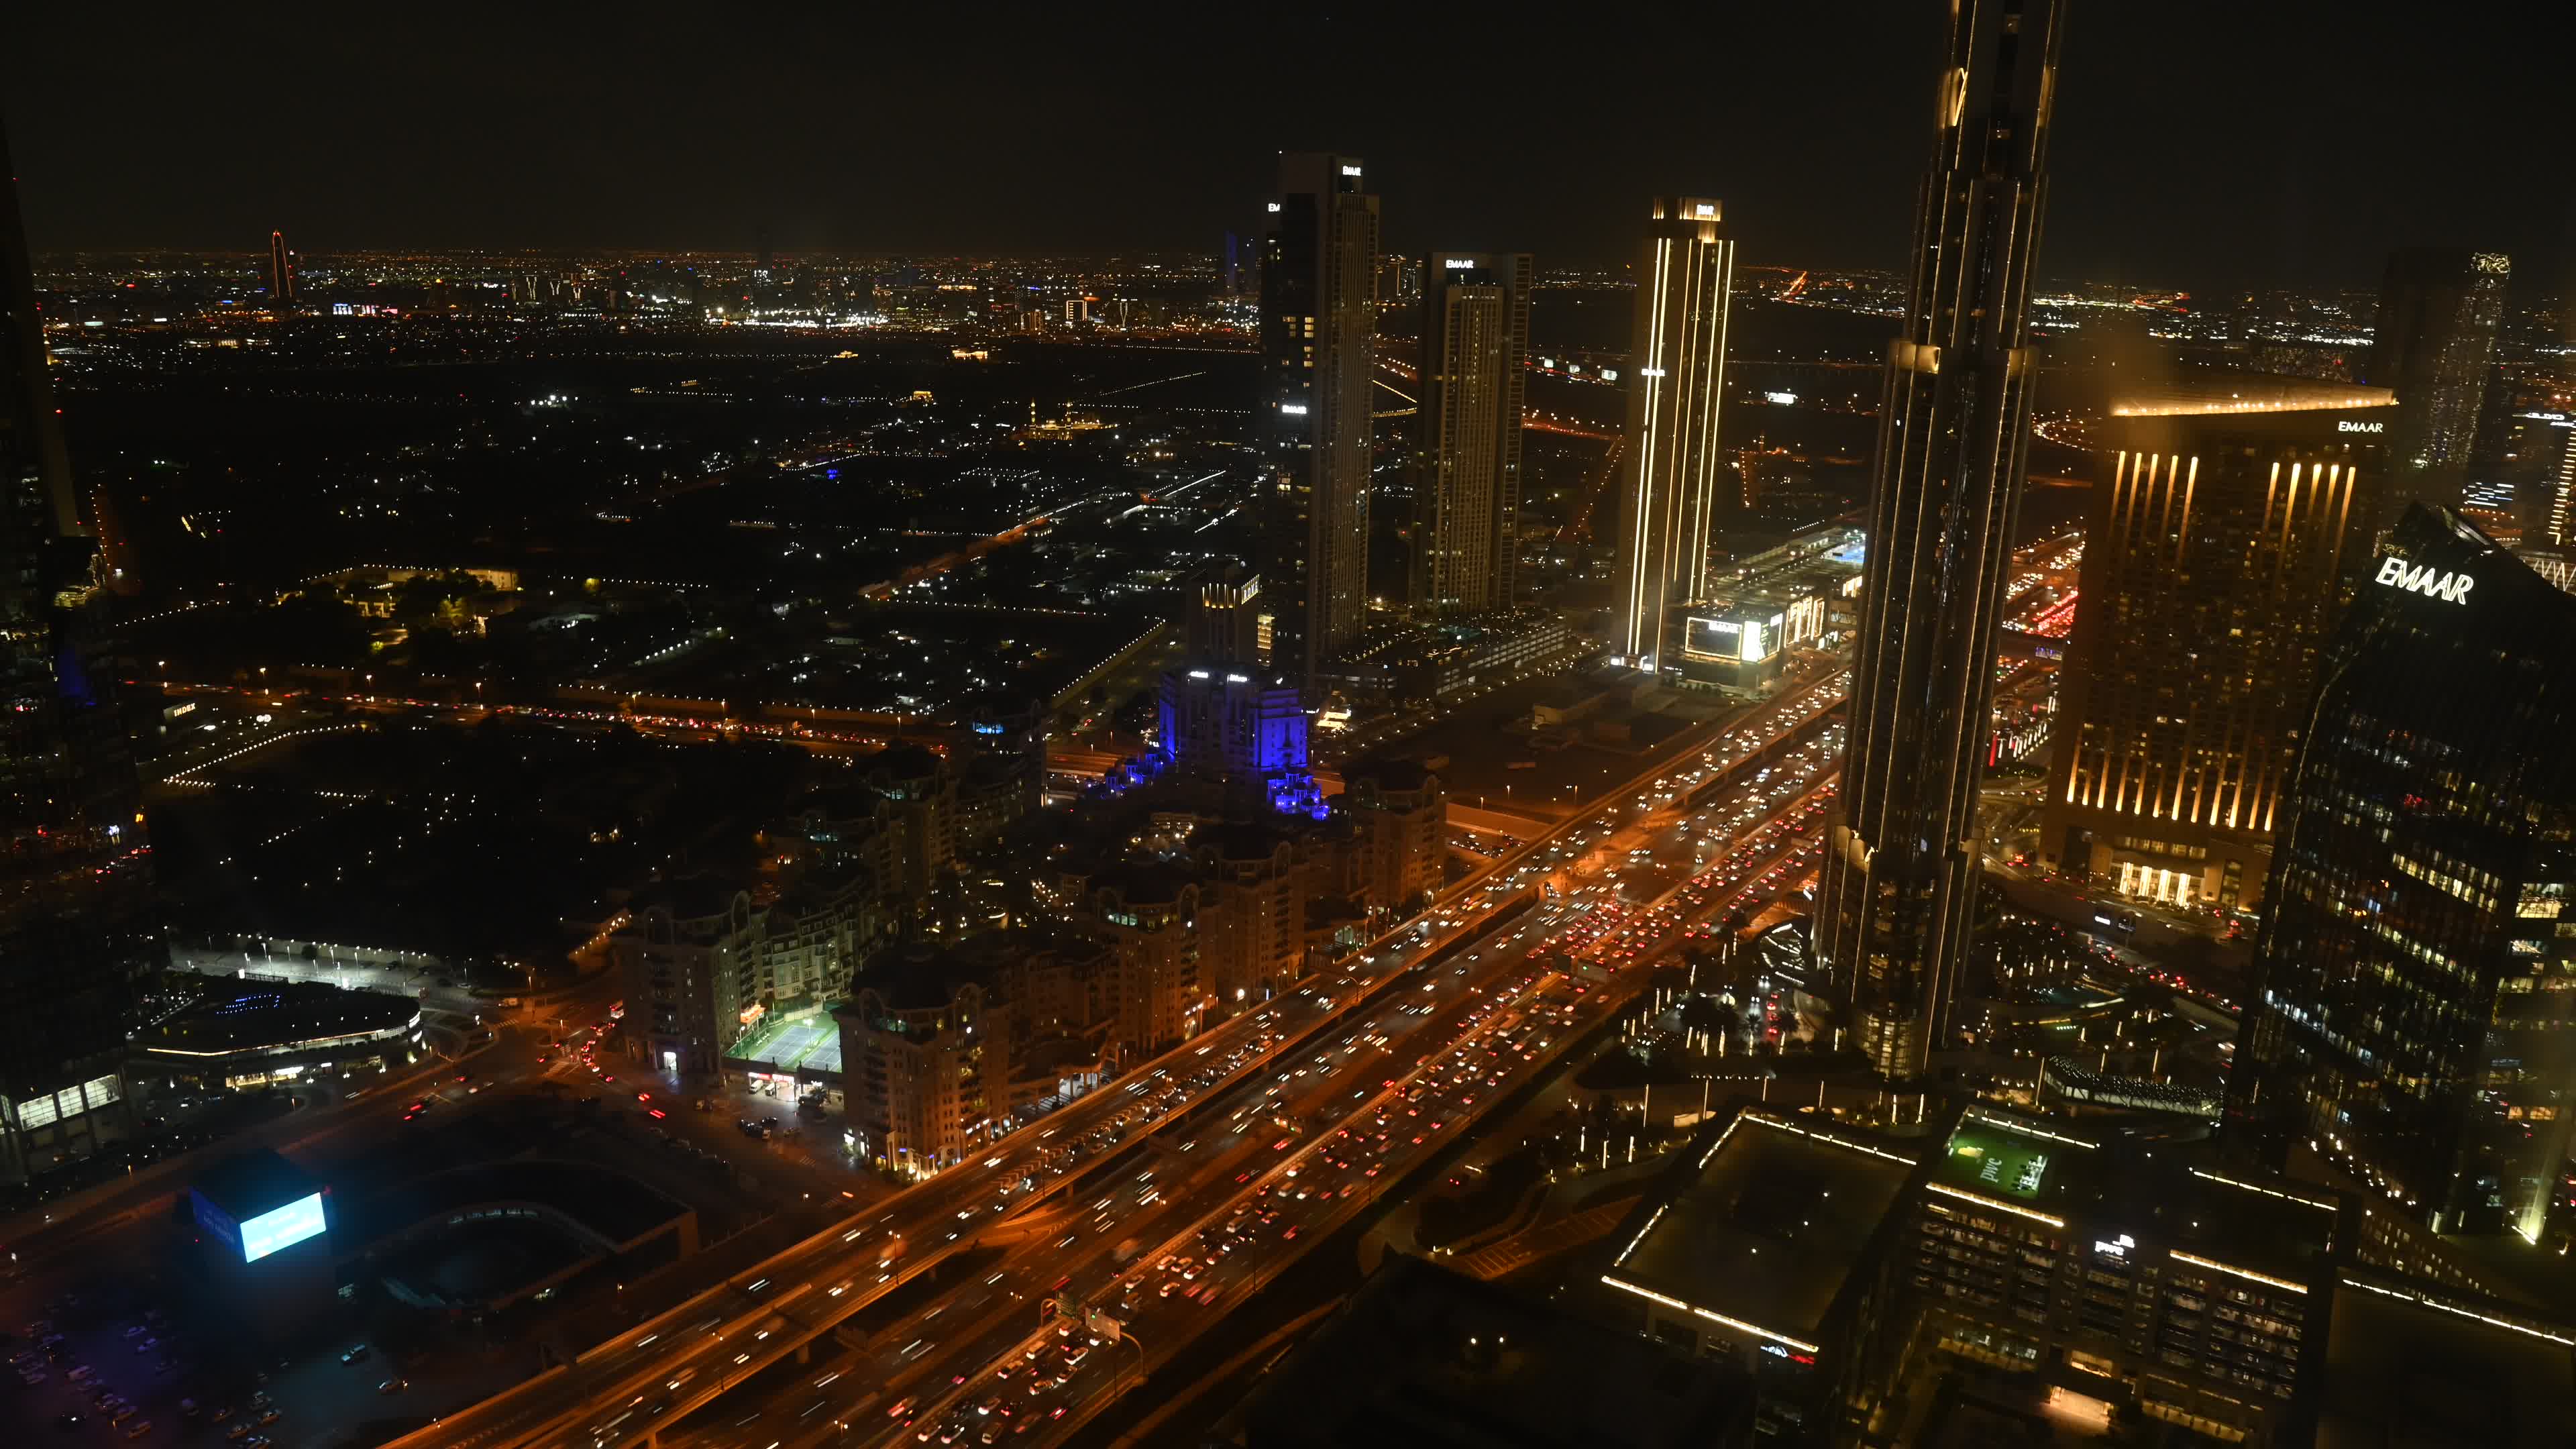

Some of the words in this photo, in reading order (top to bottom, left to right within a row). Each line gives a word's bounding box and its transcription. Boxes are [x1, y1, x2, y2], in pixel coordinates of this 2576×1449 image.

[1446, 260, 1474, 269] EMAAR
[2339, 421, 2383, 433] EMAAR
[2375, 557, 2474, 605] EMAAR
[174, 702, 196, 717] INDEX
[1980, 1157, 2002, 1183] pwc
